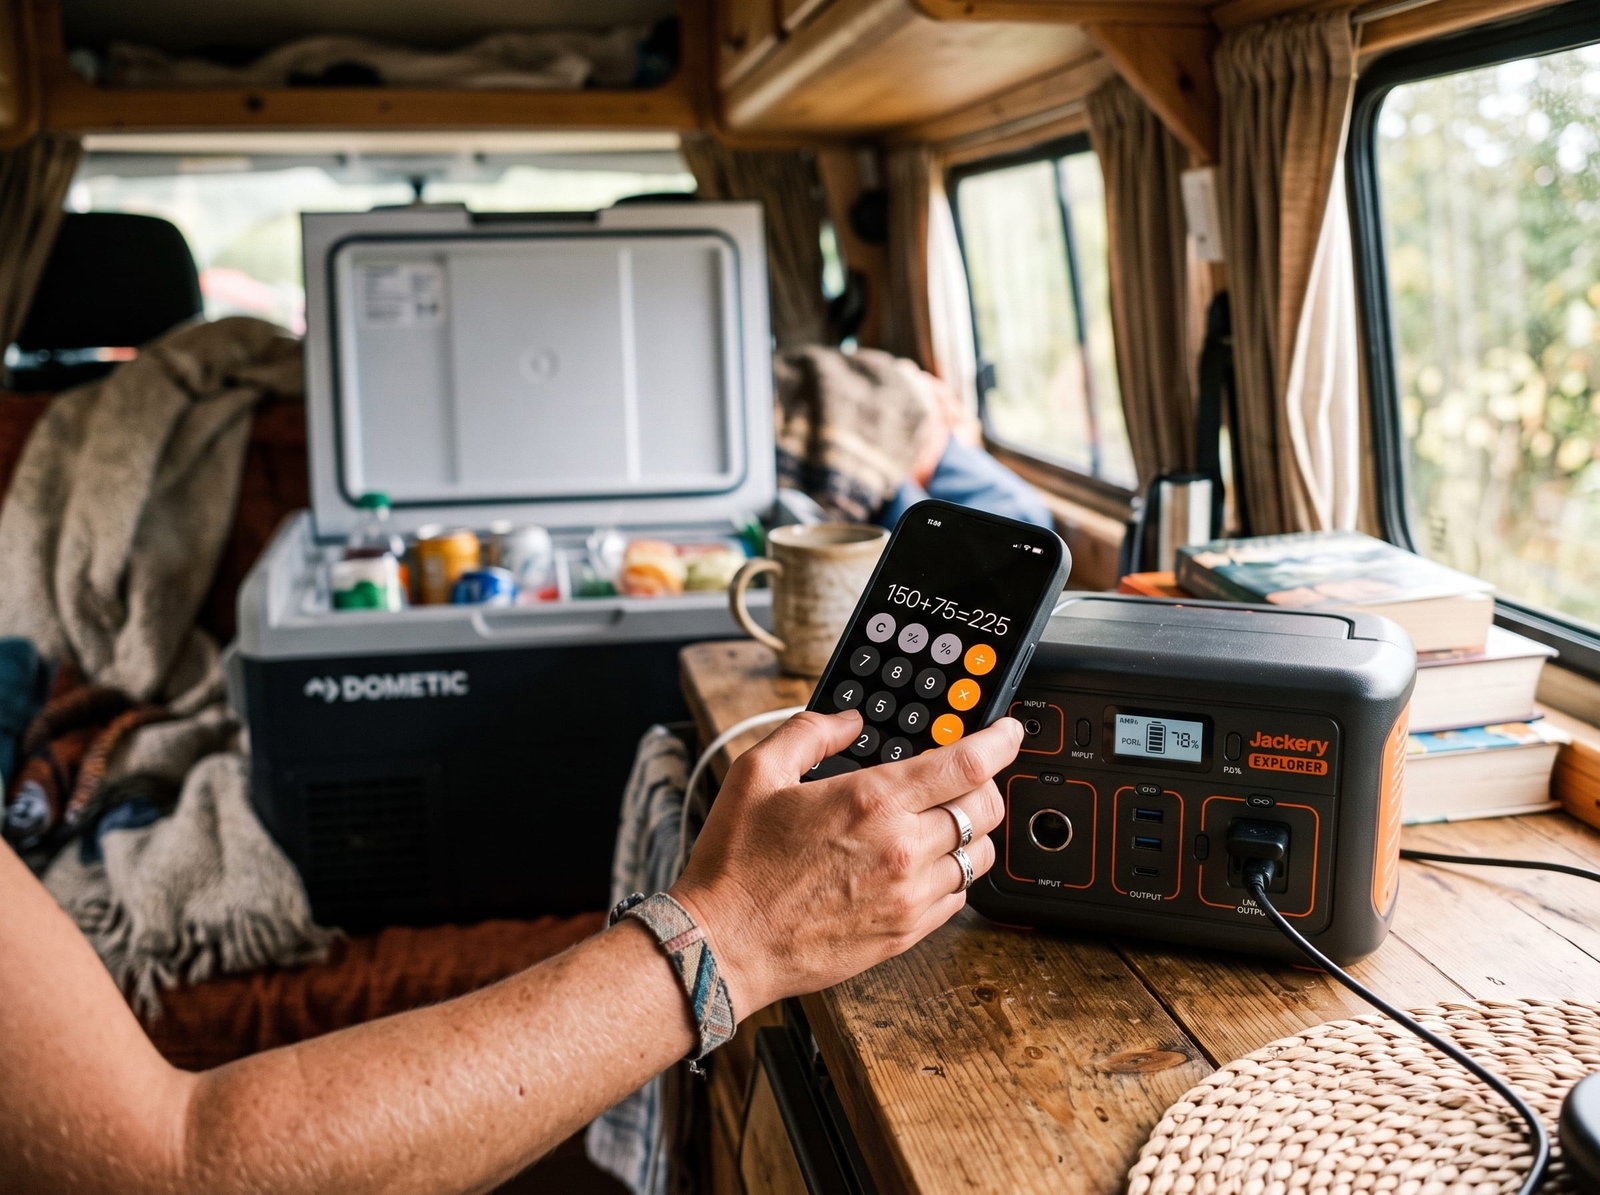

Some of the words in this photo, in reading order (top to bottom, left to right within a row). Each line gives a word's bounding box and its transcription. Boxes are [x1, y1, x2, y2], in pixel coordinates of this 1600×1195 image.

[887, 583, 1012, 636] 150+75=225
[875, 622, 887, 633] C
[859, 654, 871, 667] 7
[891, 666, 903, 679] 8
[924, 677, 936, 690] 9
[342, 670, 469, 702] DOMETIC
[842, 689, 854, 702] 4
[875, 700, 887, 713] 5
[907, 711, 919, 725] 6
[1024, 700, 1047, 709] INPUT
[857, 734, 869, 748] 2
[890, 746, 902, 760] 3
[1171, 731, 1200, 750] 78%
[1249, 731, 1329, 757] Jackery
[1253, 755, 1322, 773] EXPLORER
[1038, 878, 1061, 888] INPUT
[1129, 890, 1162, 901] OUTPUT
